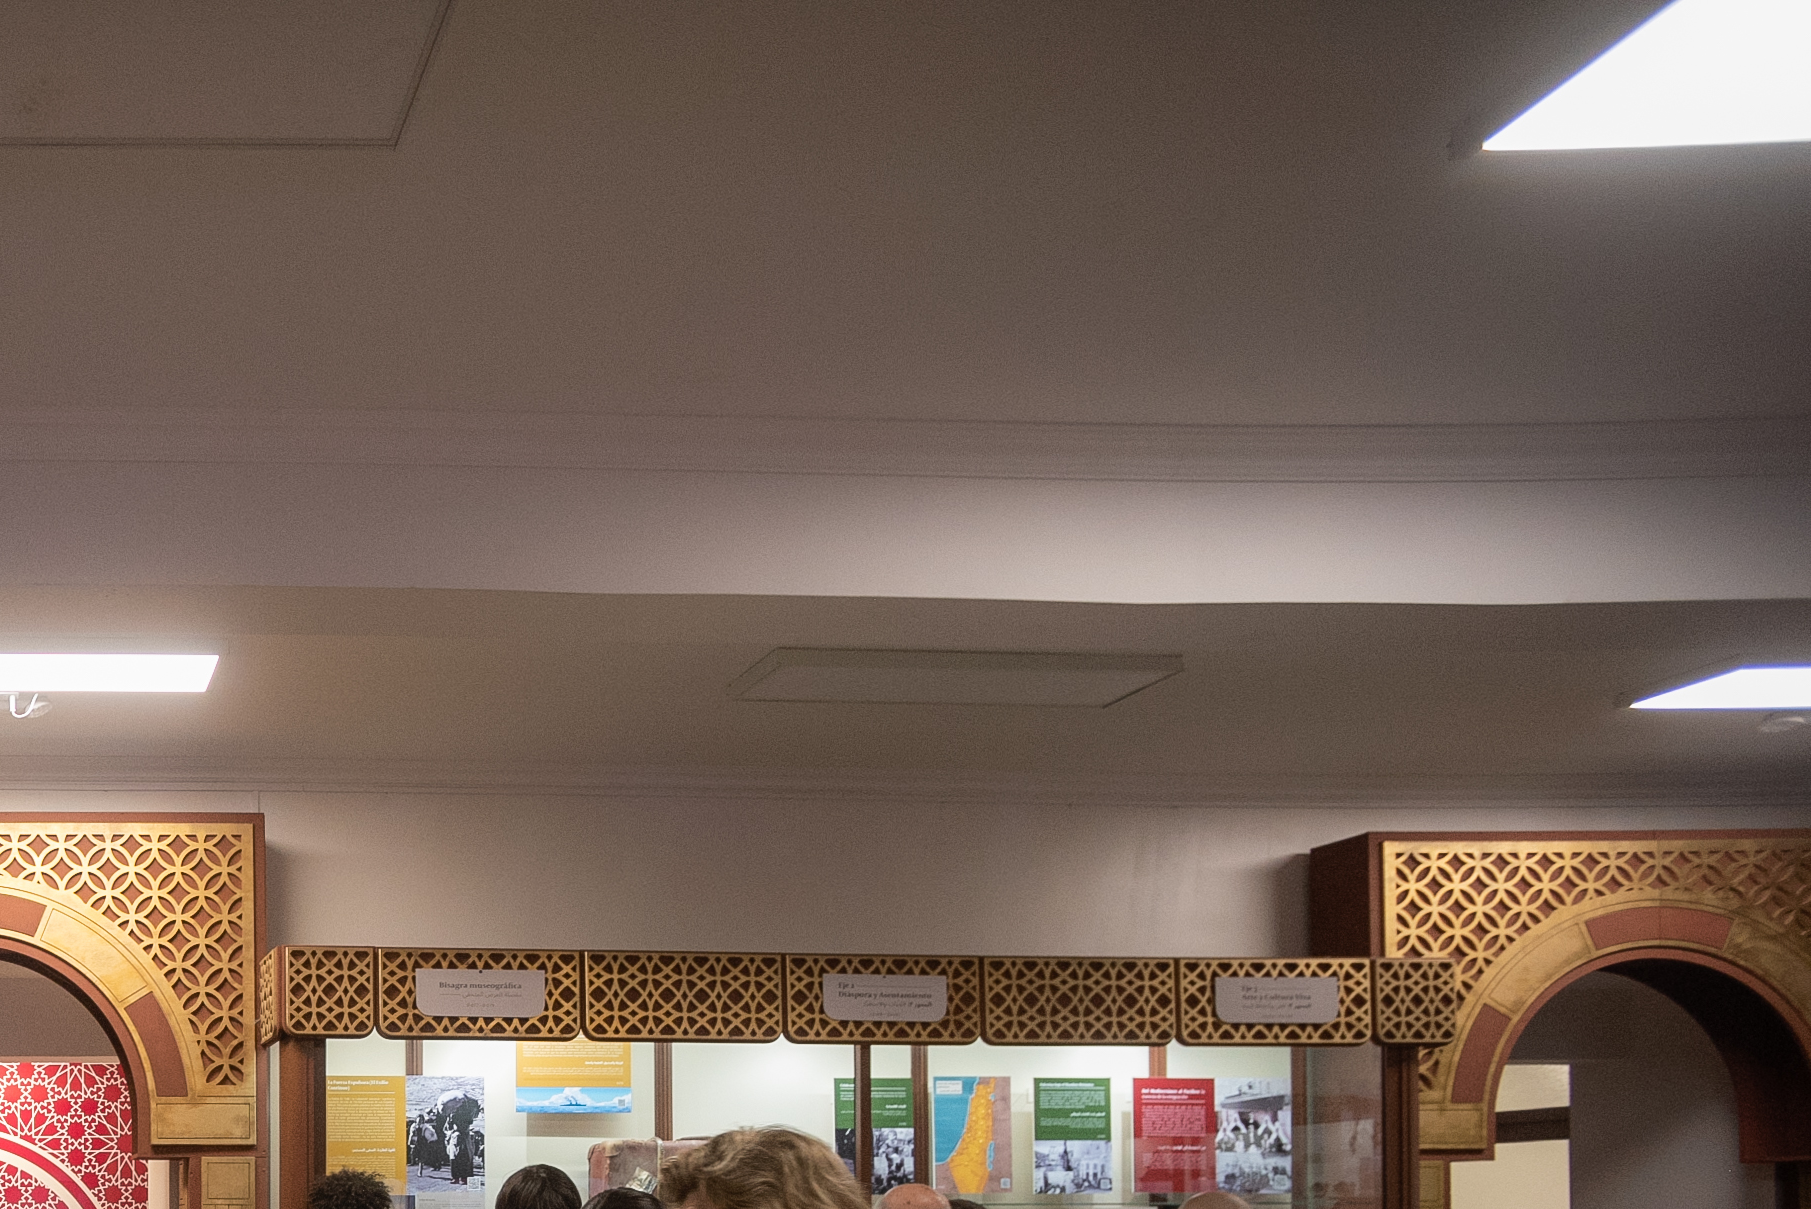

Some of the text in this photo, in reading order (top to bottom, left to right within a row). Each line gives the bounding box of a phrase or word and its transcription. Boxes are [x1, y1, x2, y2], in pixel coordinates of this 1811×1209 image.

[439, 982, 522, 990] Bisagra museográfica
[838, 991, 872, 999] Diáspora
